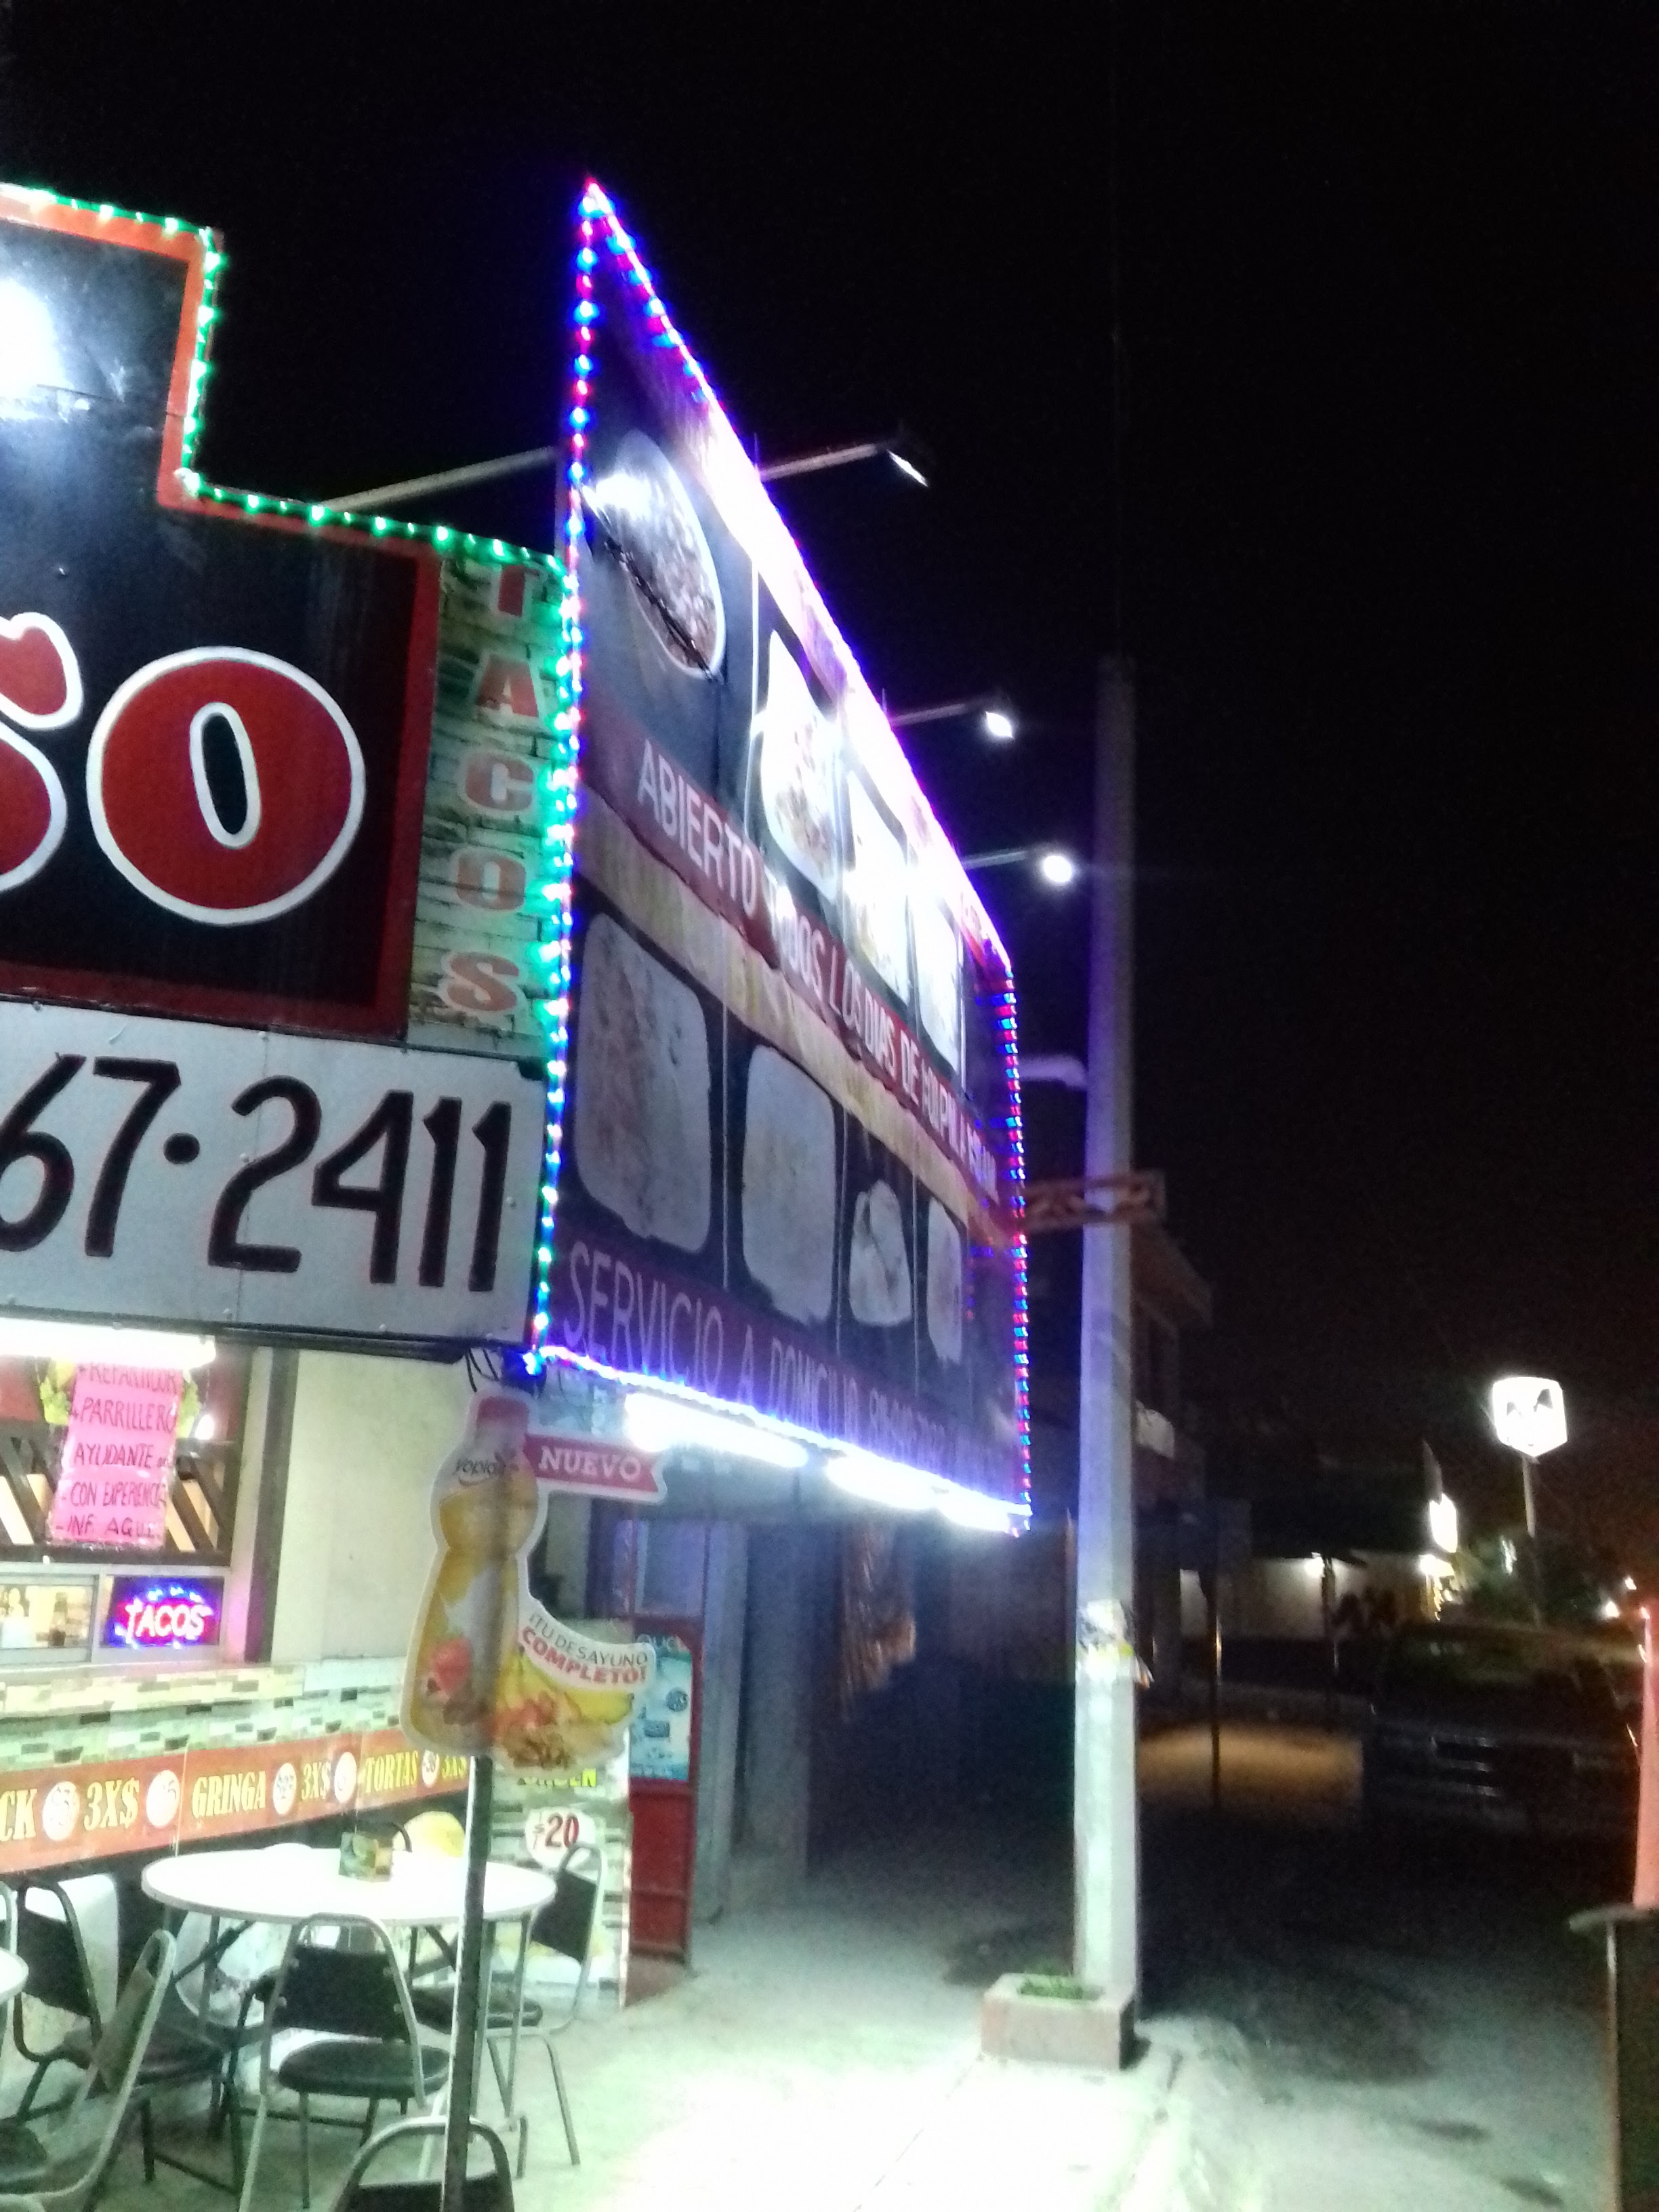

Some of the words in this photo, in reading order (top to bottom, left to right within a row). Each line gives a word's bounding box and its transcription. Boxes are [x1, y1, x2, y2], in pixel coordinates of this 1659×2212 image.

[637, 739, 759, 918] ABIERTO
[865, 986, 897, 1082] DIAS
[900, 1029, 920, 1107] DE
[562, 1240, 724, 1396] SERVICIO
[73, 1442, 155, 1469] AYUDANTE
[537, 1446, 642, 1484] NUEVO
[124, 1597, 214, 1644] TACOS
[554, 1633, 649, 1668] DESAYUNO
[84, 1778, 140, 1831] 3X$
[192, 1770, 267, 1819] GRINGA
[365, 1750, 426, 1794] TORTAS
